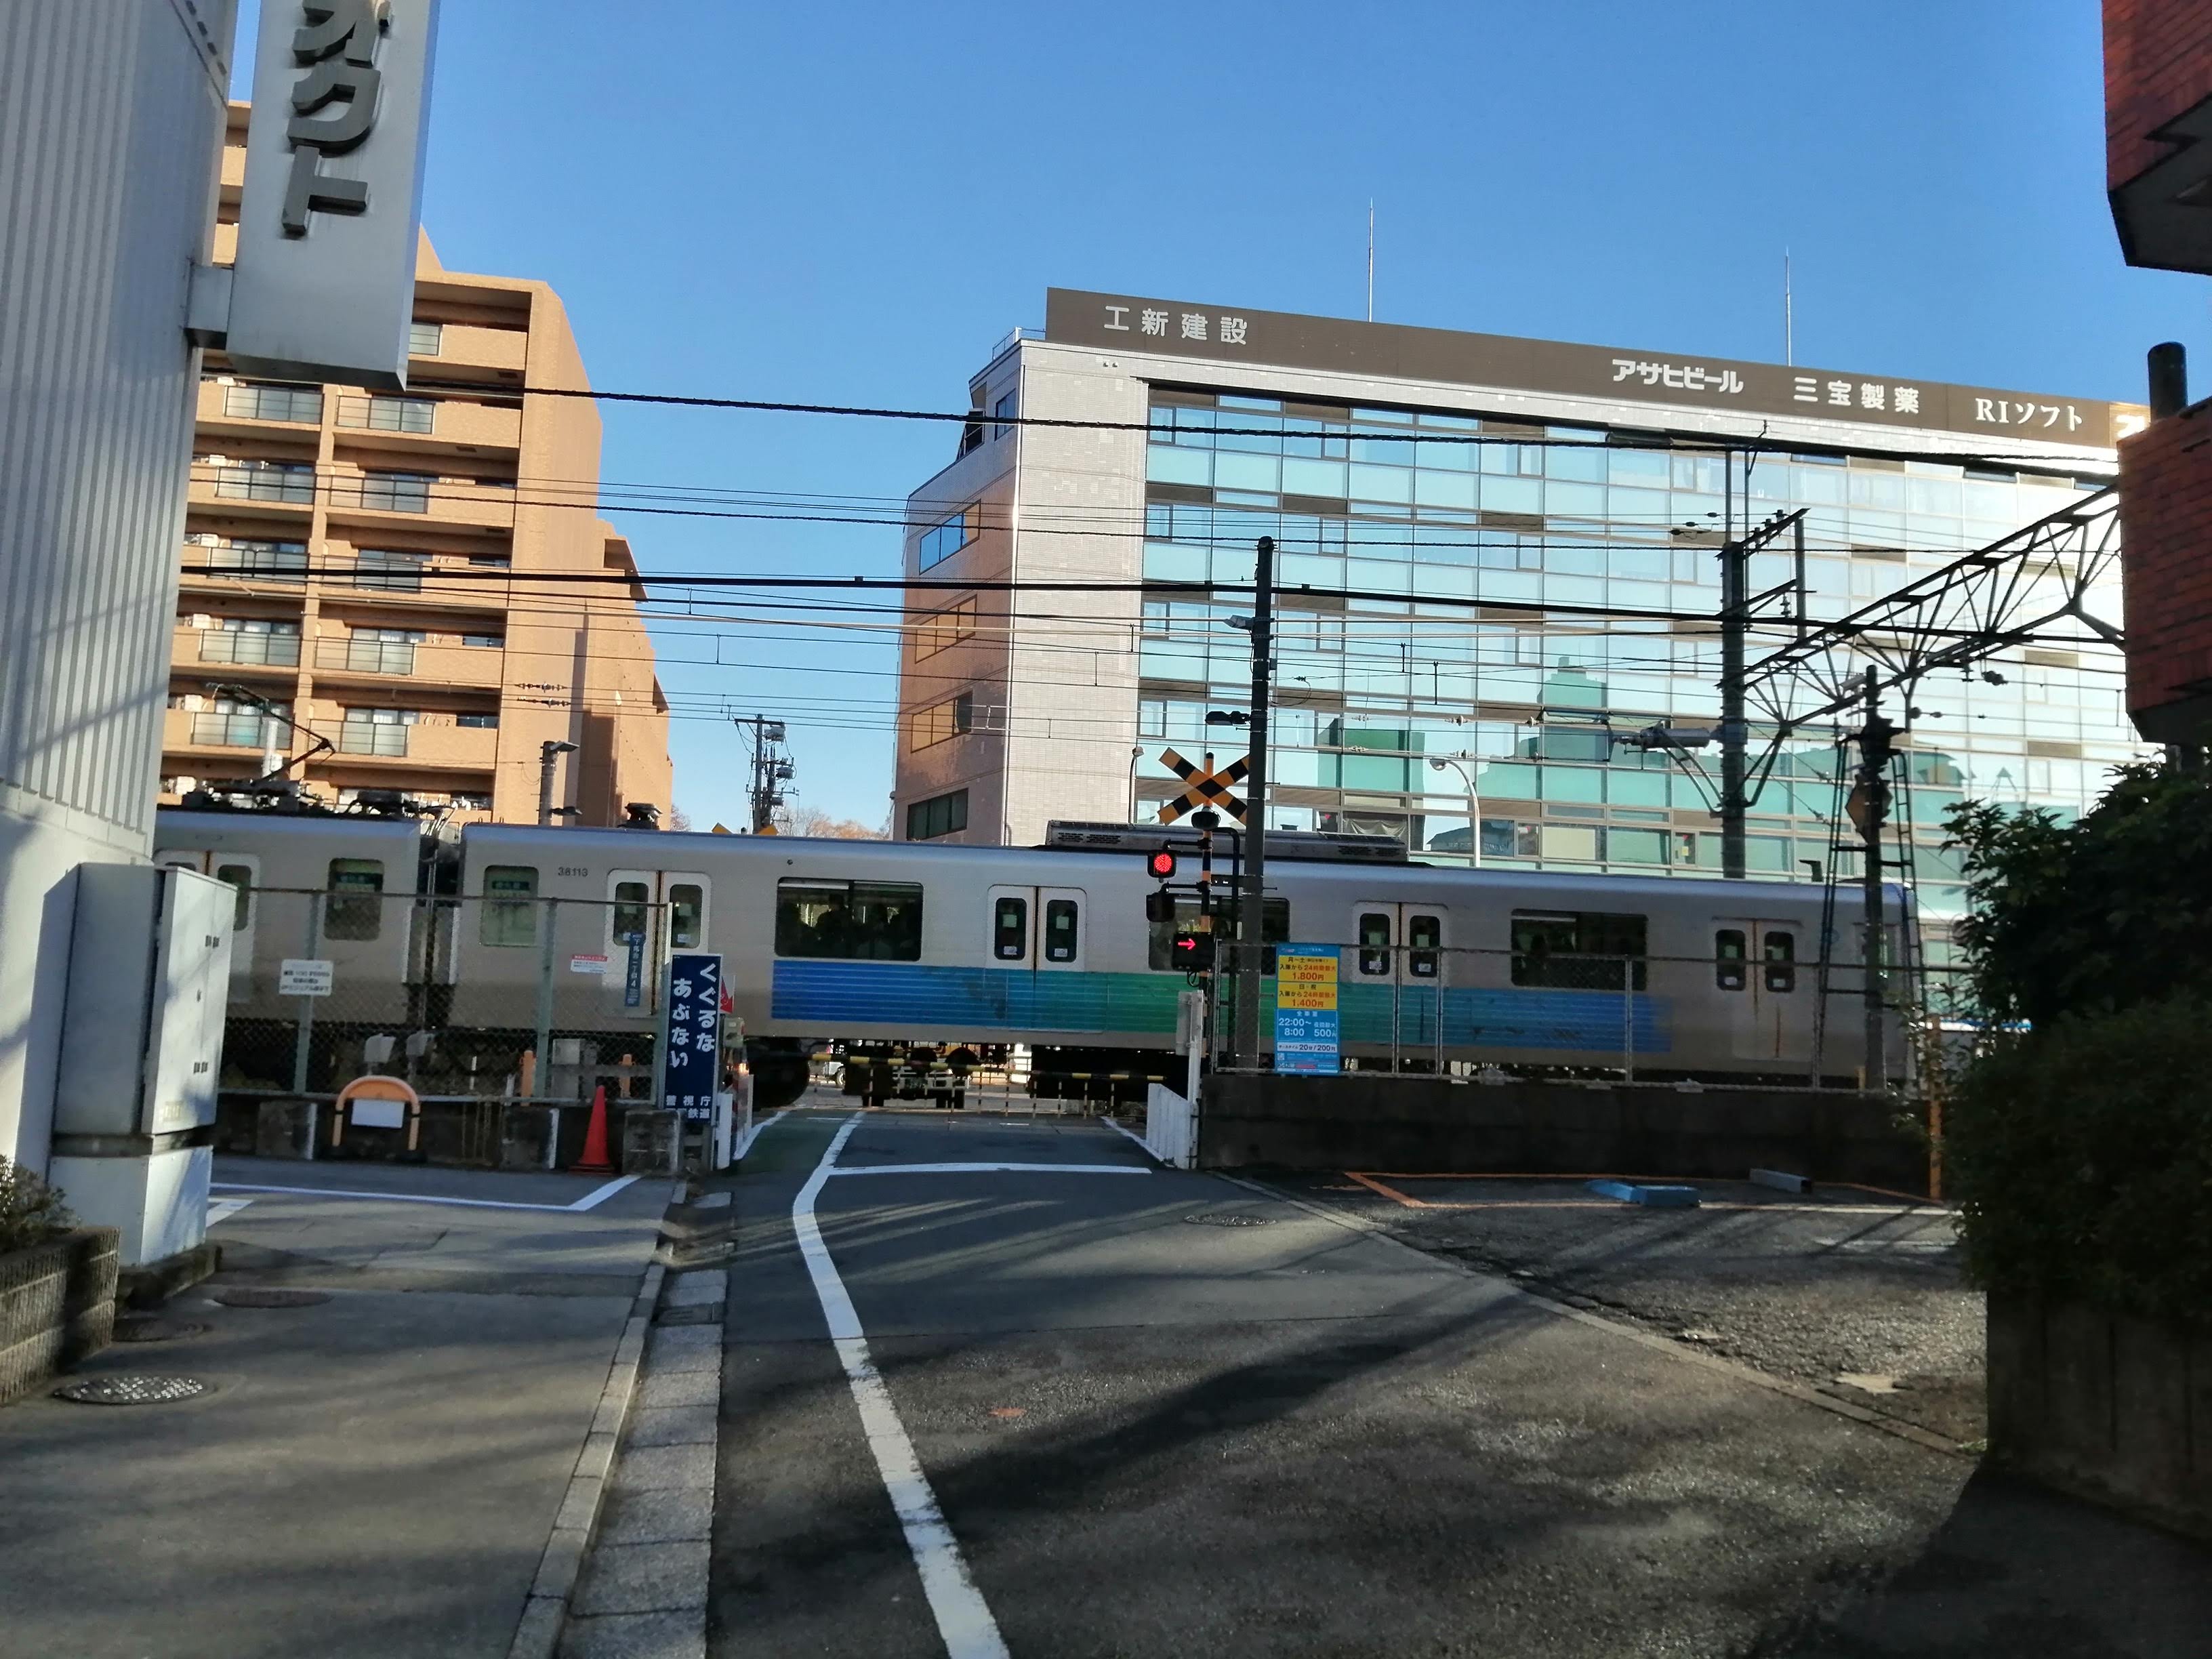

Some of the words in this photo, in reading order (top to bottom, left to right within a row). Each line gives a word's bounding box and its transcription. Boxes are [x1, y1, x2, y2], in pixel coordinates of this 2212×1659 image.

[1612, 359, 1744, 394] アサヒビール
[1793, 377, 1919, 414] 三宝製薬
[1975, 398, 2083, 432] RIソフト
[670, 978, 692, 1068] あぶない
[696, 963, 717, 1052] くぐるな
[1284, 1027, 1305, 1037] 8:00
[666, 1094, 712, 1107] 警視庁
